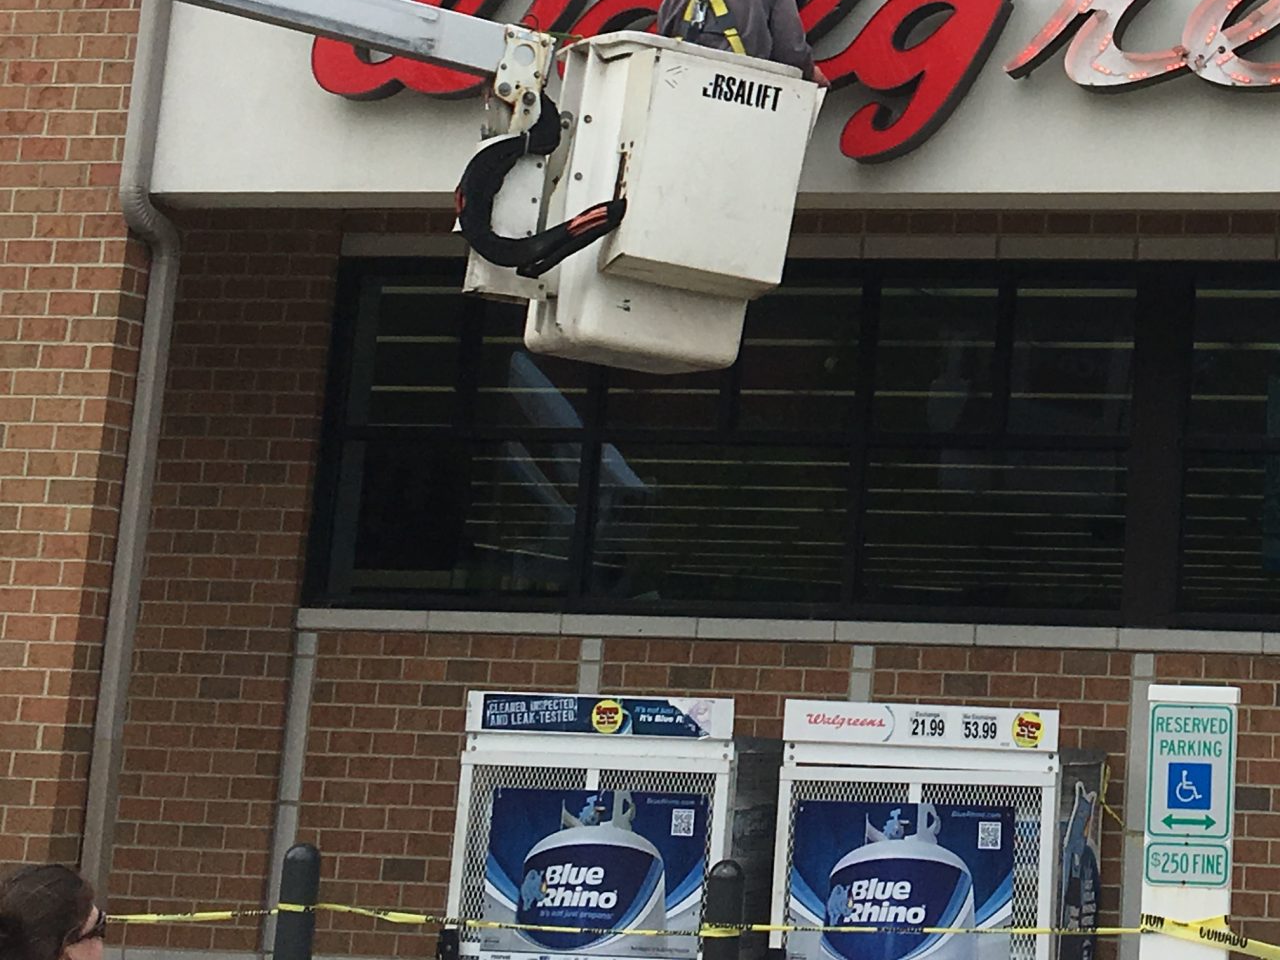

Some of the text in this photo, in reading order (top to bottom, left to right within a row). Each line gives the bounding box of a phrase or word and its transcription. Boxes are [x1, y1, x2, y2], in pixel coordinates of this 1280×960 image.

[489, 714, 509, 727] AND
[654, 714, 674, 723] Blue
[806, 712, 886, 730] Walgreens
[1156, 716, 1228, 734] RESERVED
[1159, 739, 1222, 757] PARKING
[544, 862, 604, 885] Blue
[1150, 851, 1223, 875] $250 FINE
[536, 887, 618, 909] Rhino
[851, 877, 912, 900] Blue
[843, 903, 927, 924] Rhino
[1199, 926, 1248, 948] CUIDADO
